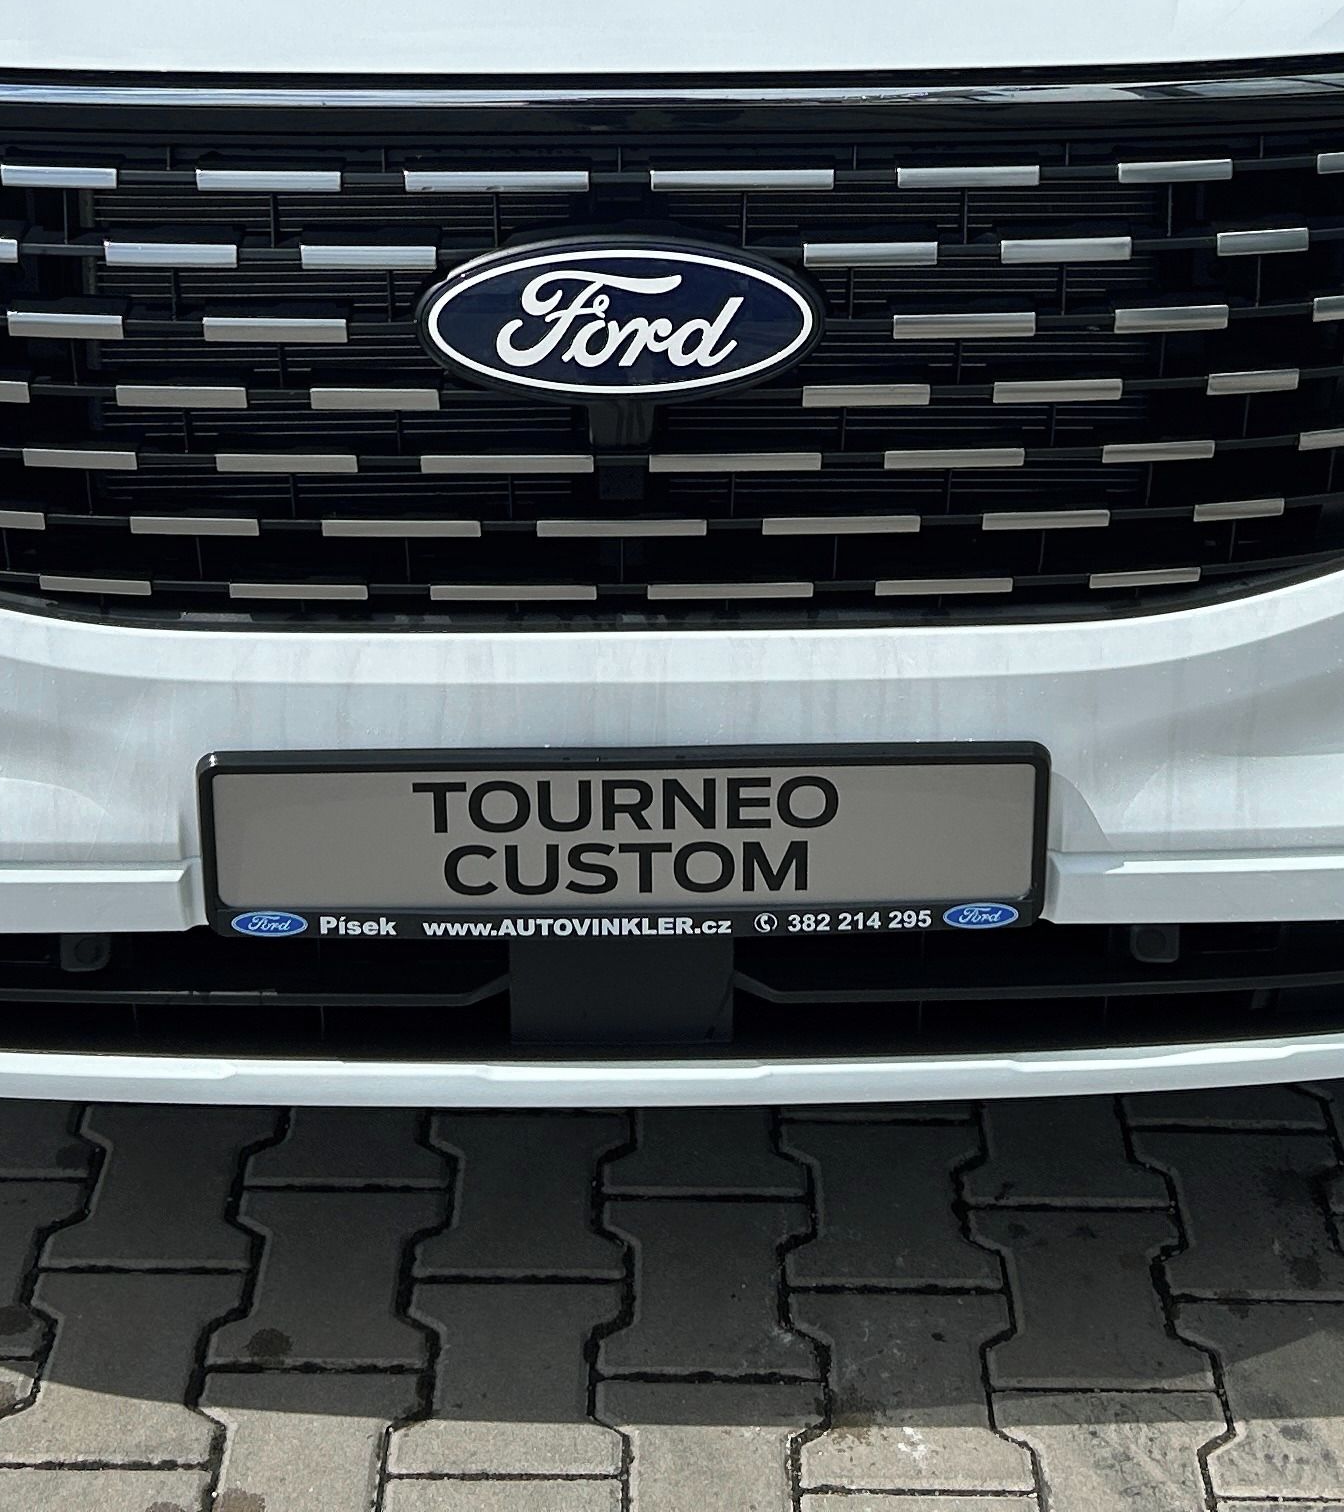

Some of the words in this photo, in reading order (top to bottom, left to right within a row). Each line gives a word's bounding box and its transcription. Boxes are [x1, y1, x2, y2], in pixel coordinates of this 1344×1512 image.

[496, 270, 744, 368] Ford
[411, 774, 840, 834] TOURNEO
[443, 840, 809, 896] CUSTOM
[247, 914, 291, 932] Ford
[319, 915, 397, 937] Písek
[422, 917, 732, 938] www.AUTOVINKLER.cz
[787, 913, 830, 933] 382
[837, 912, 882, 932] 214
[888, 910, 932, 929] 295
[958, 906, 1002, 924] Ford
